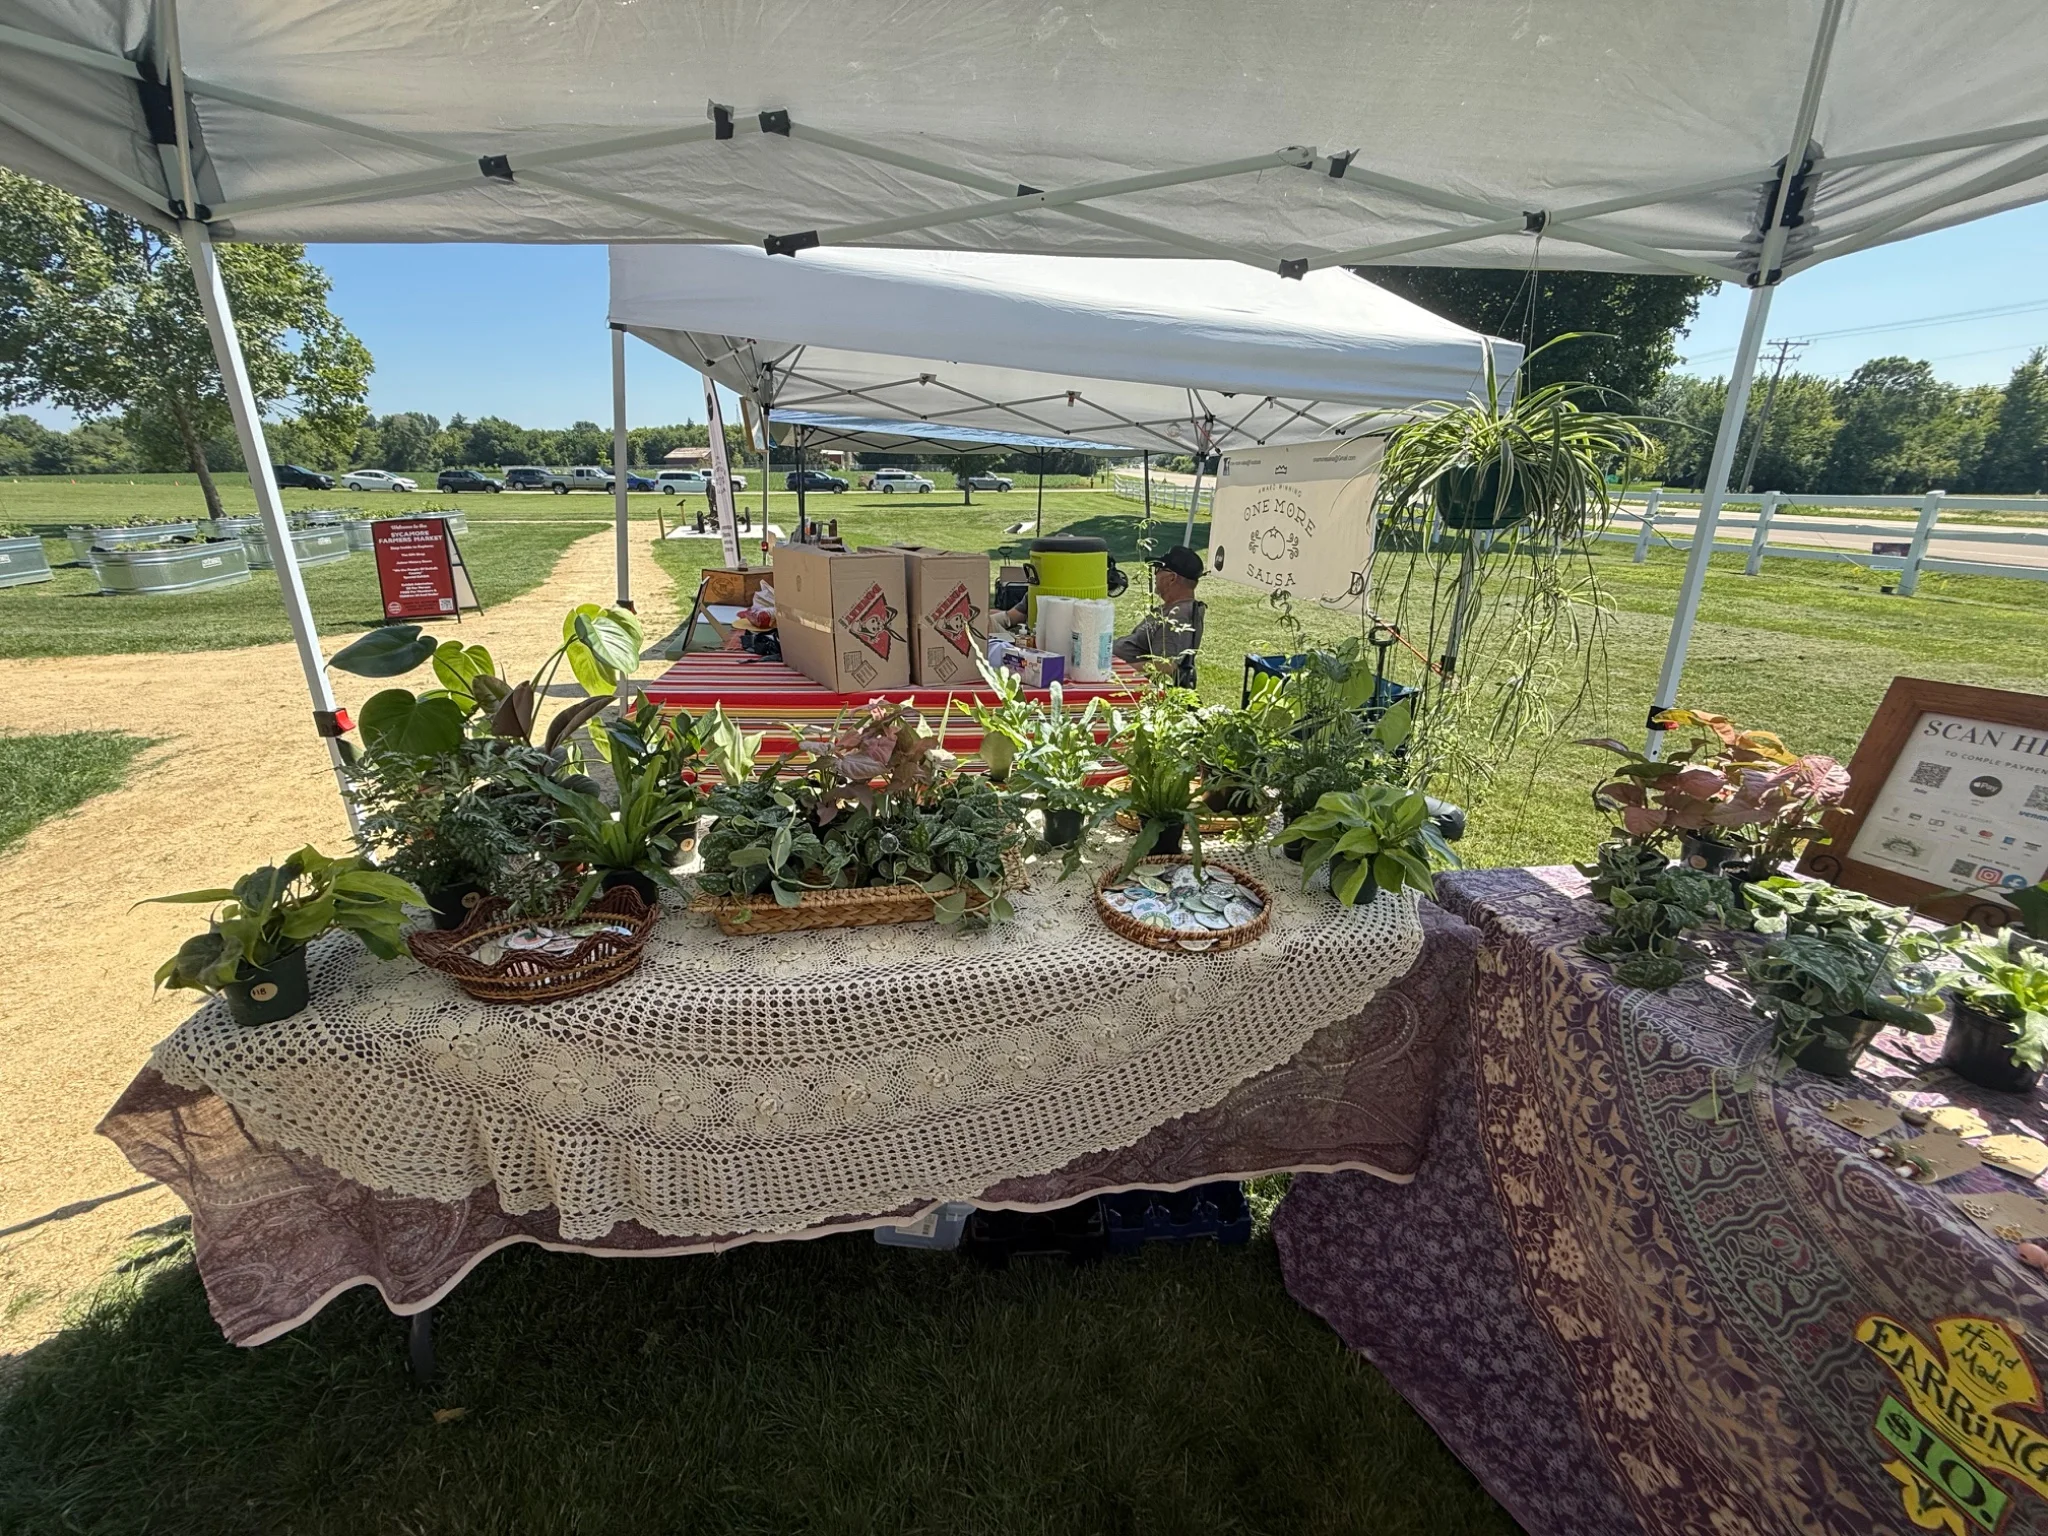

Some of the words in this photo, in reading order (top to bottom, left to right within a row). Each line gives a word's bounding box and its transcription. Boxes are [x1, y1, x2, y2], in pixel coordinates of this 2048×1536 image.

[1243, 499, 1270, 522] ONE
[1273, 498, 1316, 538] MORE
[390, 530, 429, 538] SYCAMORE
[1246, 563, 1296, 587] SALSA
[1923, 719, 2007, 748] SCAN
[1944, 750, 1958, 758] TO
[1961, 753, 2002, 766] COMPLE
[1980, 782, 1998, 793] Pay
[1954, 1322, 2021, 1370] Hand
[1950, 1347, 2008, 1395] Made
